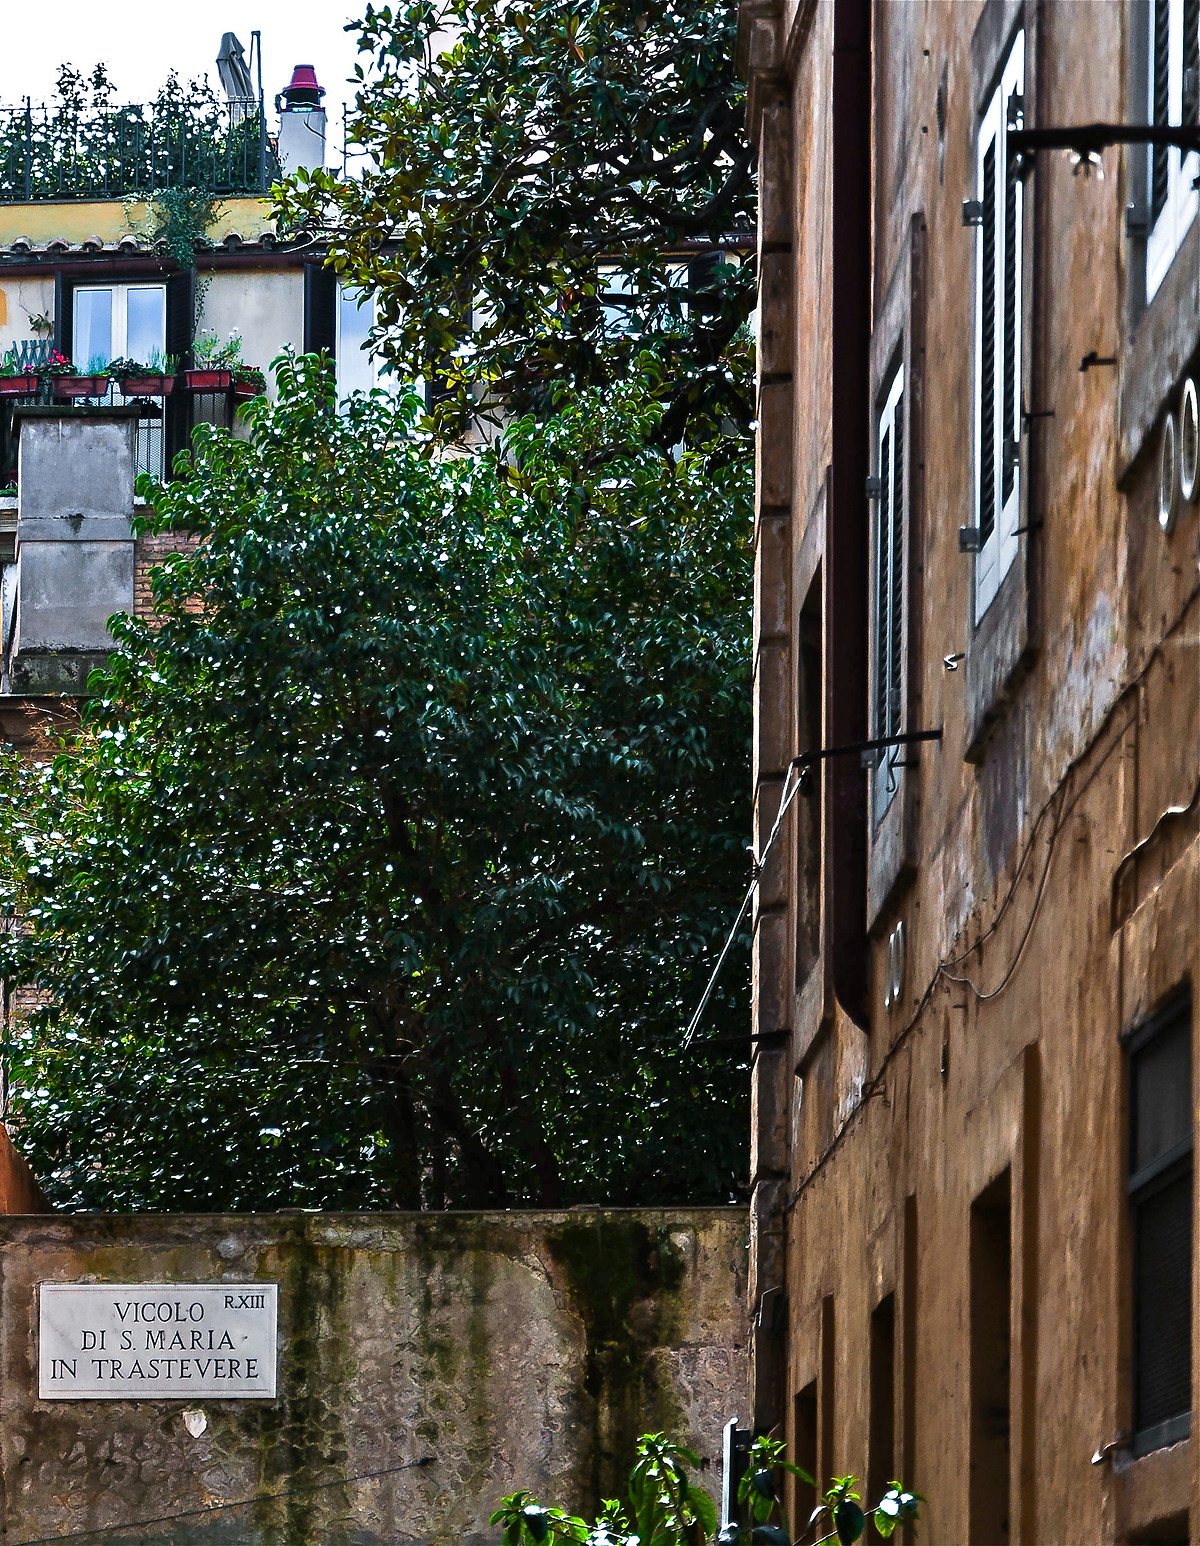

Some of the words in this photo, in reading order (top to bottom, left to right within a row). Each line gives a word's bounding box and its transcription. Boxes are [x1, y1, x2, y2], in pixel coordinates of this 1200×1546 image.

[113, 1302, 205, 1323] VICOLO
[224, 1295, 265, 1309] R.XIII
[81, 1330, 106, 1351] DI
[144, 1330, 236, 1350] MARIA
[50, 1358, 78, 1380] IN
[91, 1358, 259, 1379] TRASTEVERE
